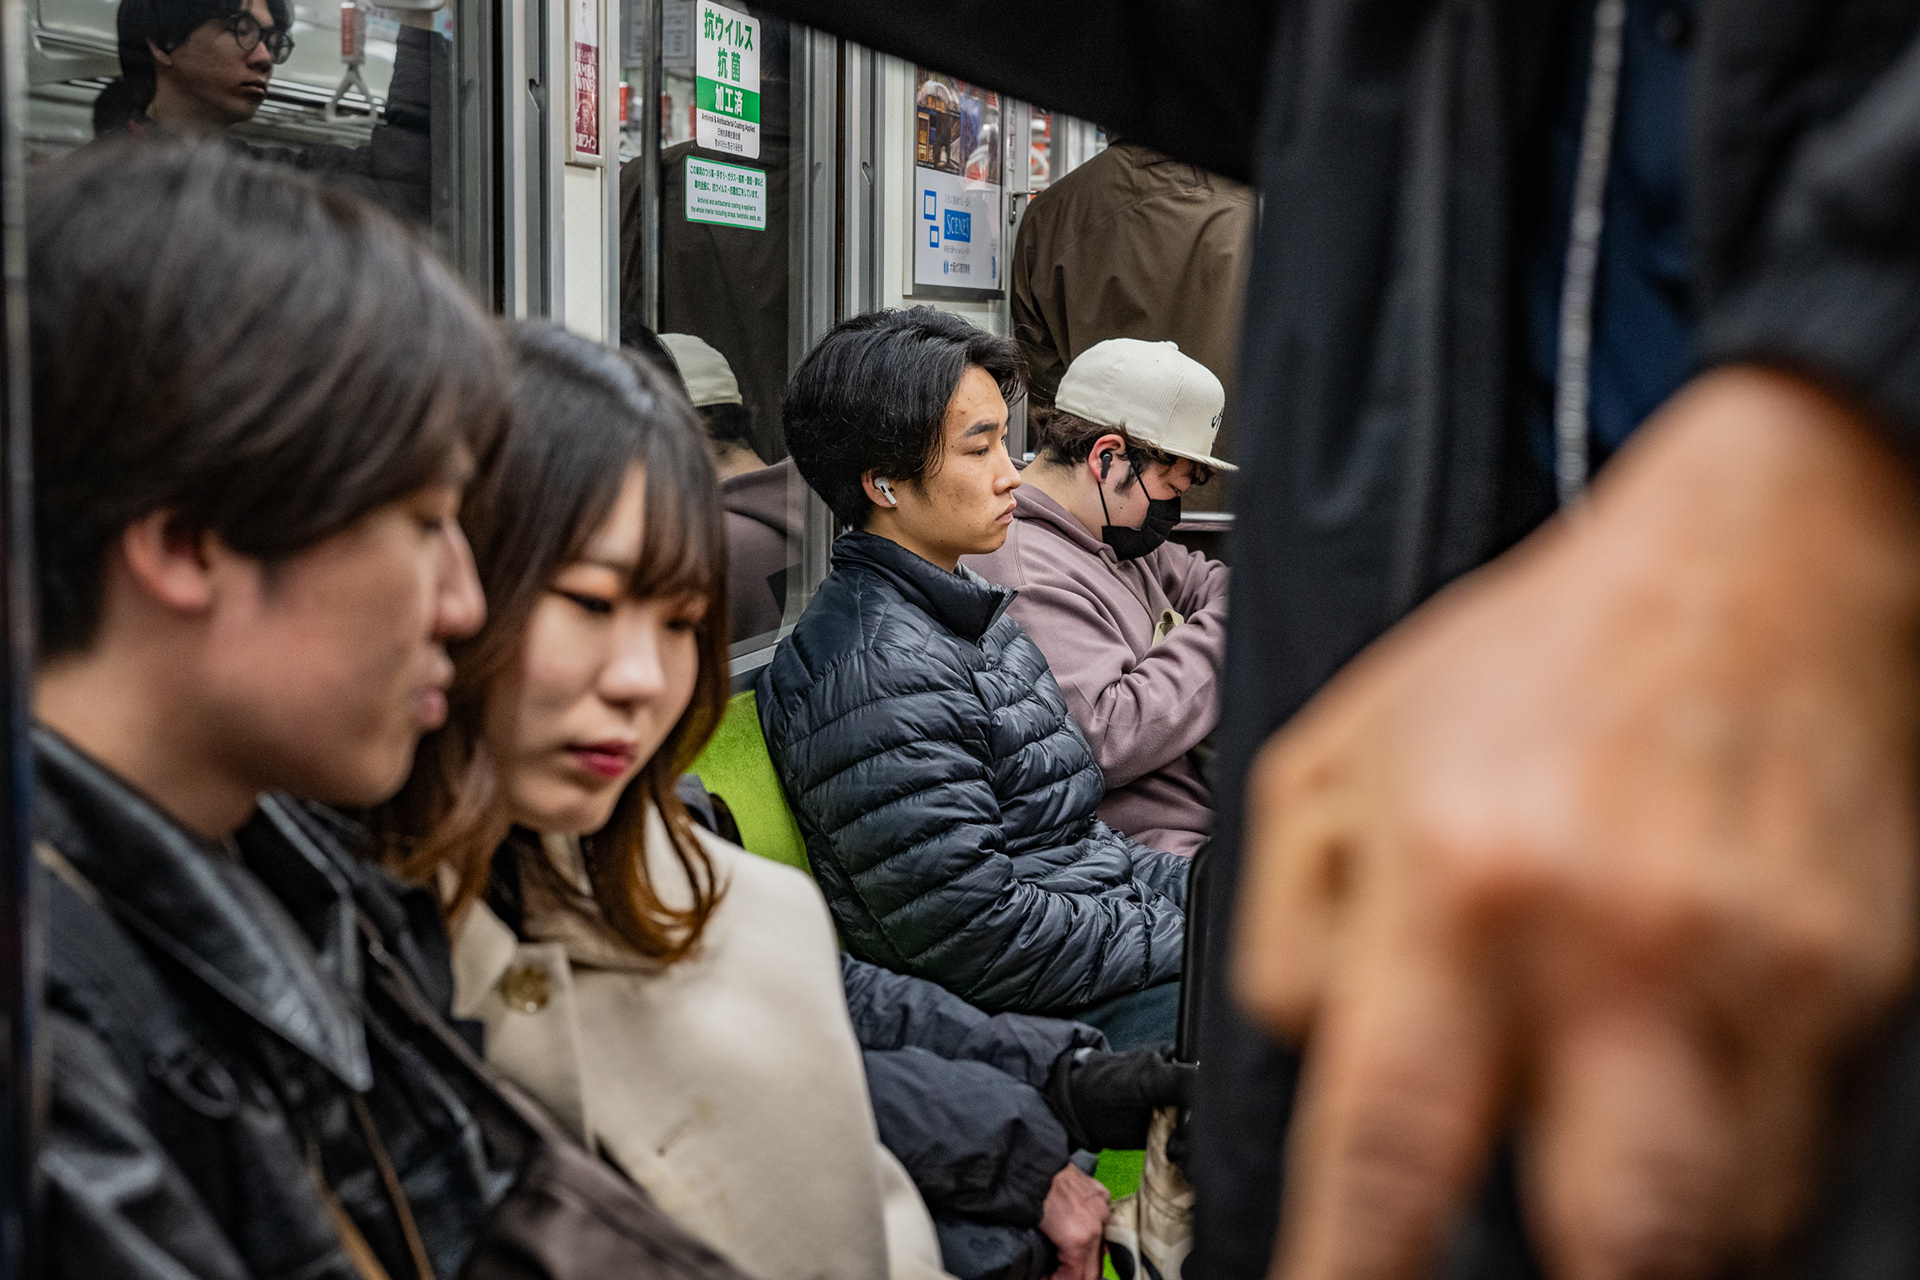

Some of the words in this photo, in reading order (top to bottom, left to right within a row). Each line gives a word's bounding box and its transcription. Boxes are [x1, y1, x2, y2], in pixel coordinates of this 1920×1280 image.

[704, 7, 753, 52] 抗ウイルス
[717, 46, 741, 83] 抗菌
[715, 83, 743, 117] 加工済
[716, 116, 734, 127] Antibacterial
[734, 120, 745, 132] Coating
[745, 124, 756, 133] Applied
[946, 214, 970, 238] SCENES
